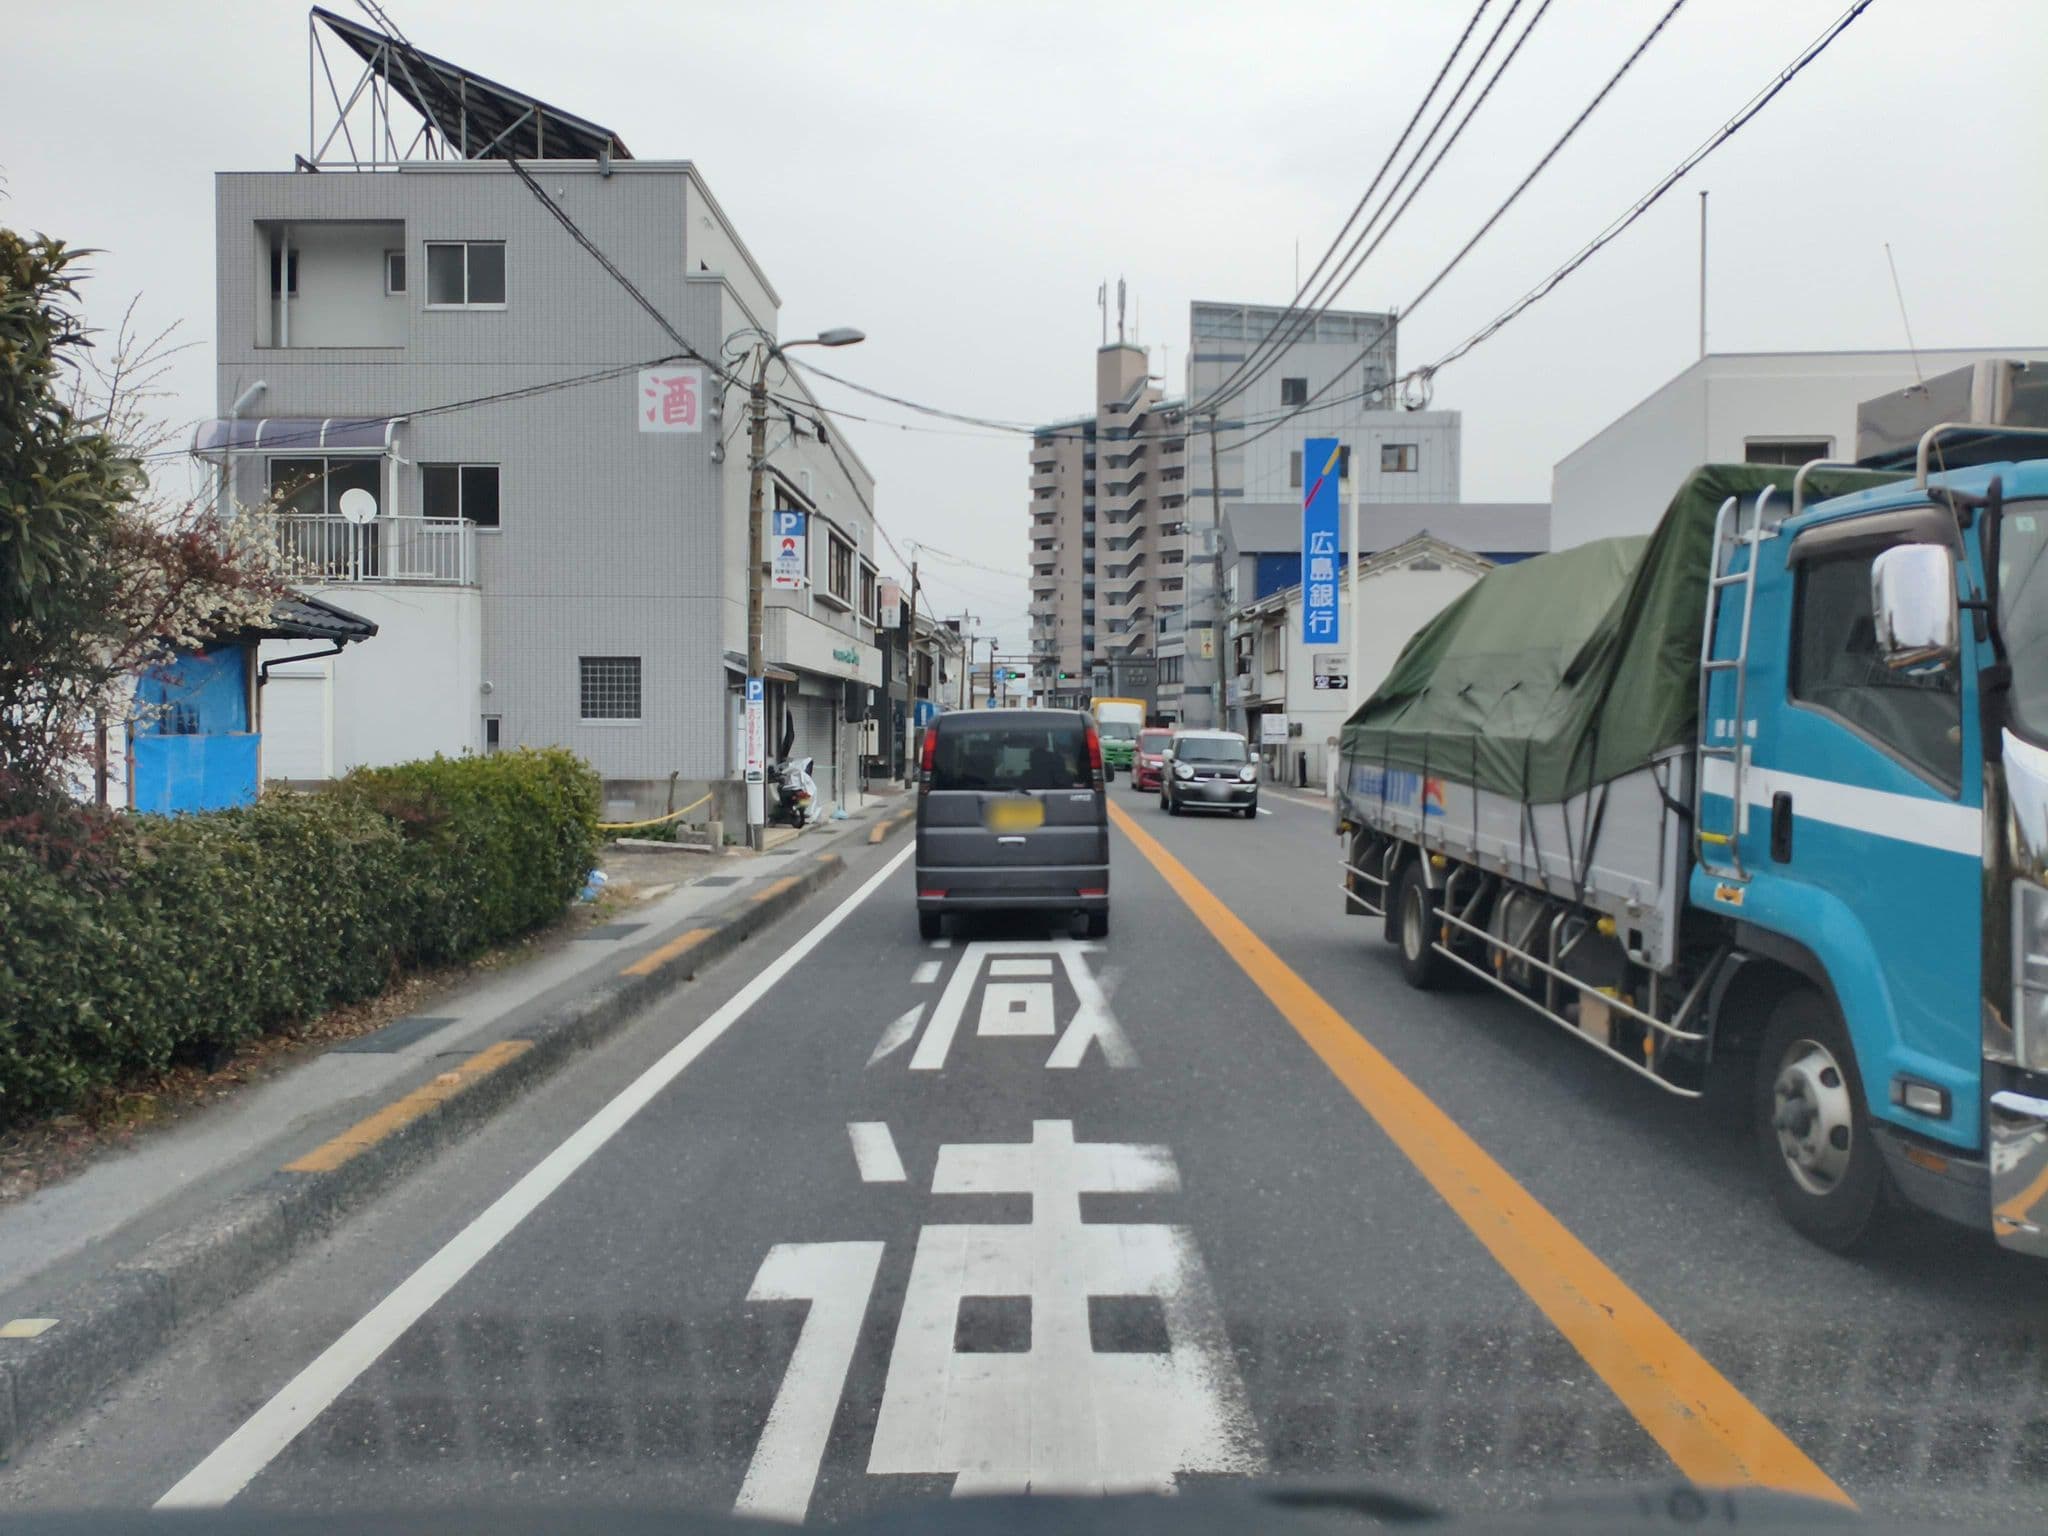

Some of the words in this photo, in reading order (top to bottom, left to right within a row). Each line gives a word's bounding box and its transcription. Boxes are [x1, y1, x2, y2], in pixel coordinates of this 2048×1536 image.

[644, 375, 698, 428] 酒
[780, 512, 797, 534] P
[1309, 530, 1335, 635] 広島銀行
[749, 681, 762, 699] P
